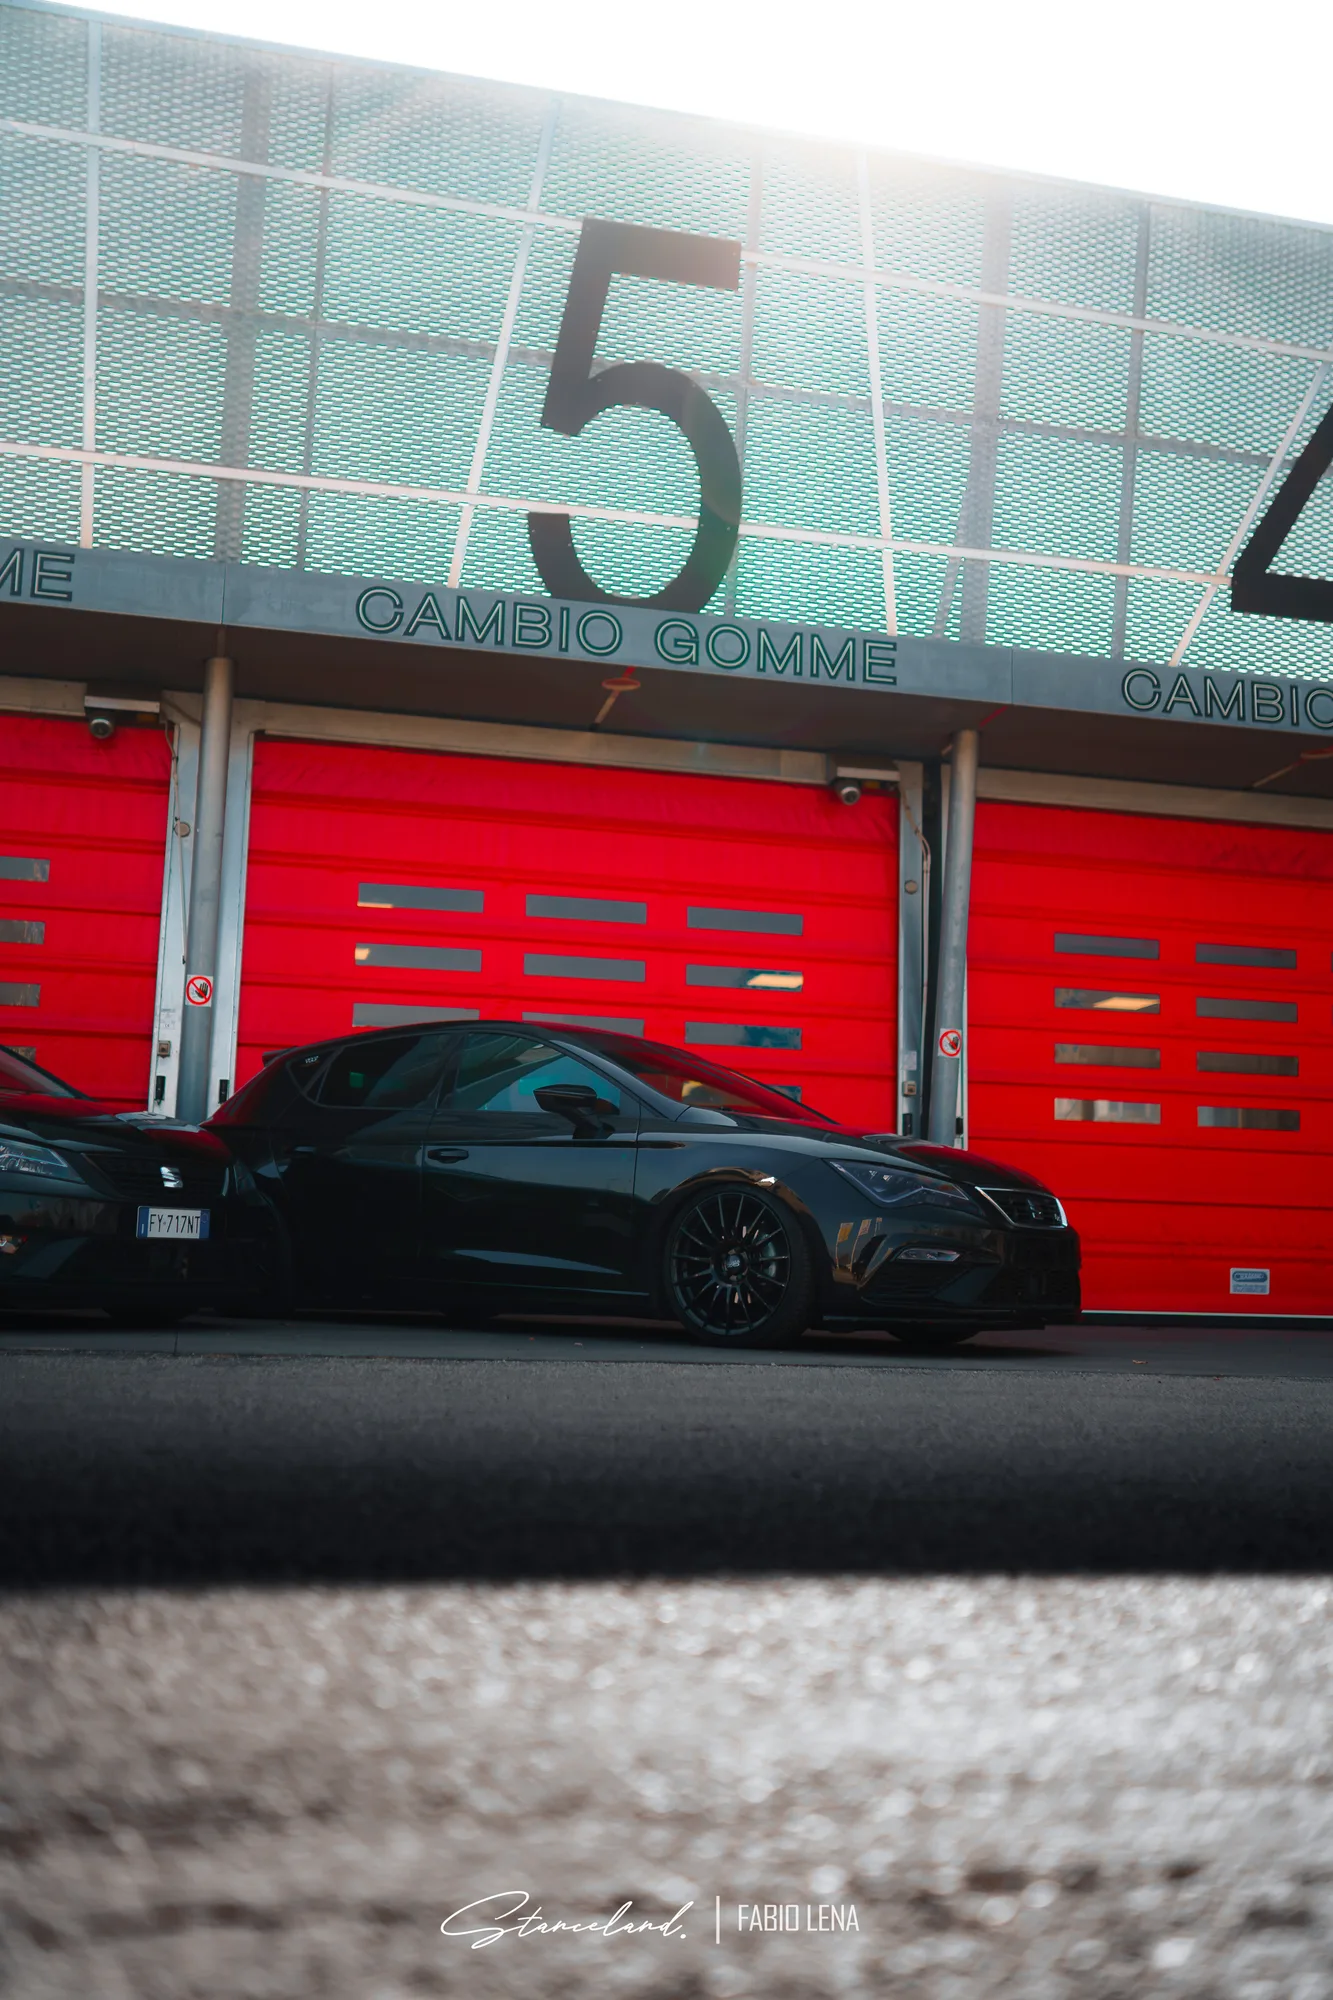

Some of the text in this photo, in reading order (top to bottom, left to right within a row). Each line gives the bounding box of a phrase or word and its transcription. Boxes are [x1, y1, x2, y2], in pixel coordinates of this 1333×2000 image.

[527, 217, 742, 614] 5
[355, 585, 898, 686] CAMBIO GOMME
[1121, 667, 1333, 730] CAMBIO
